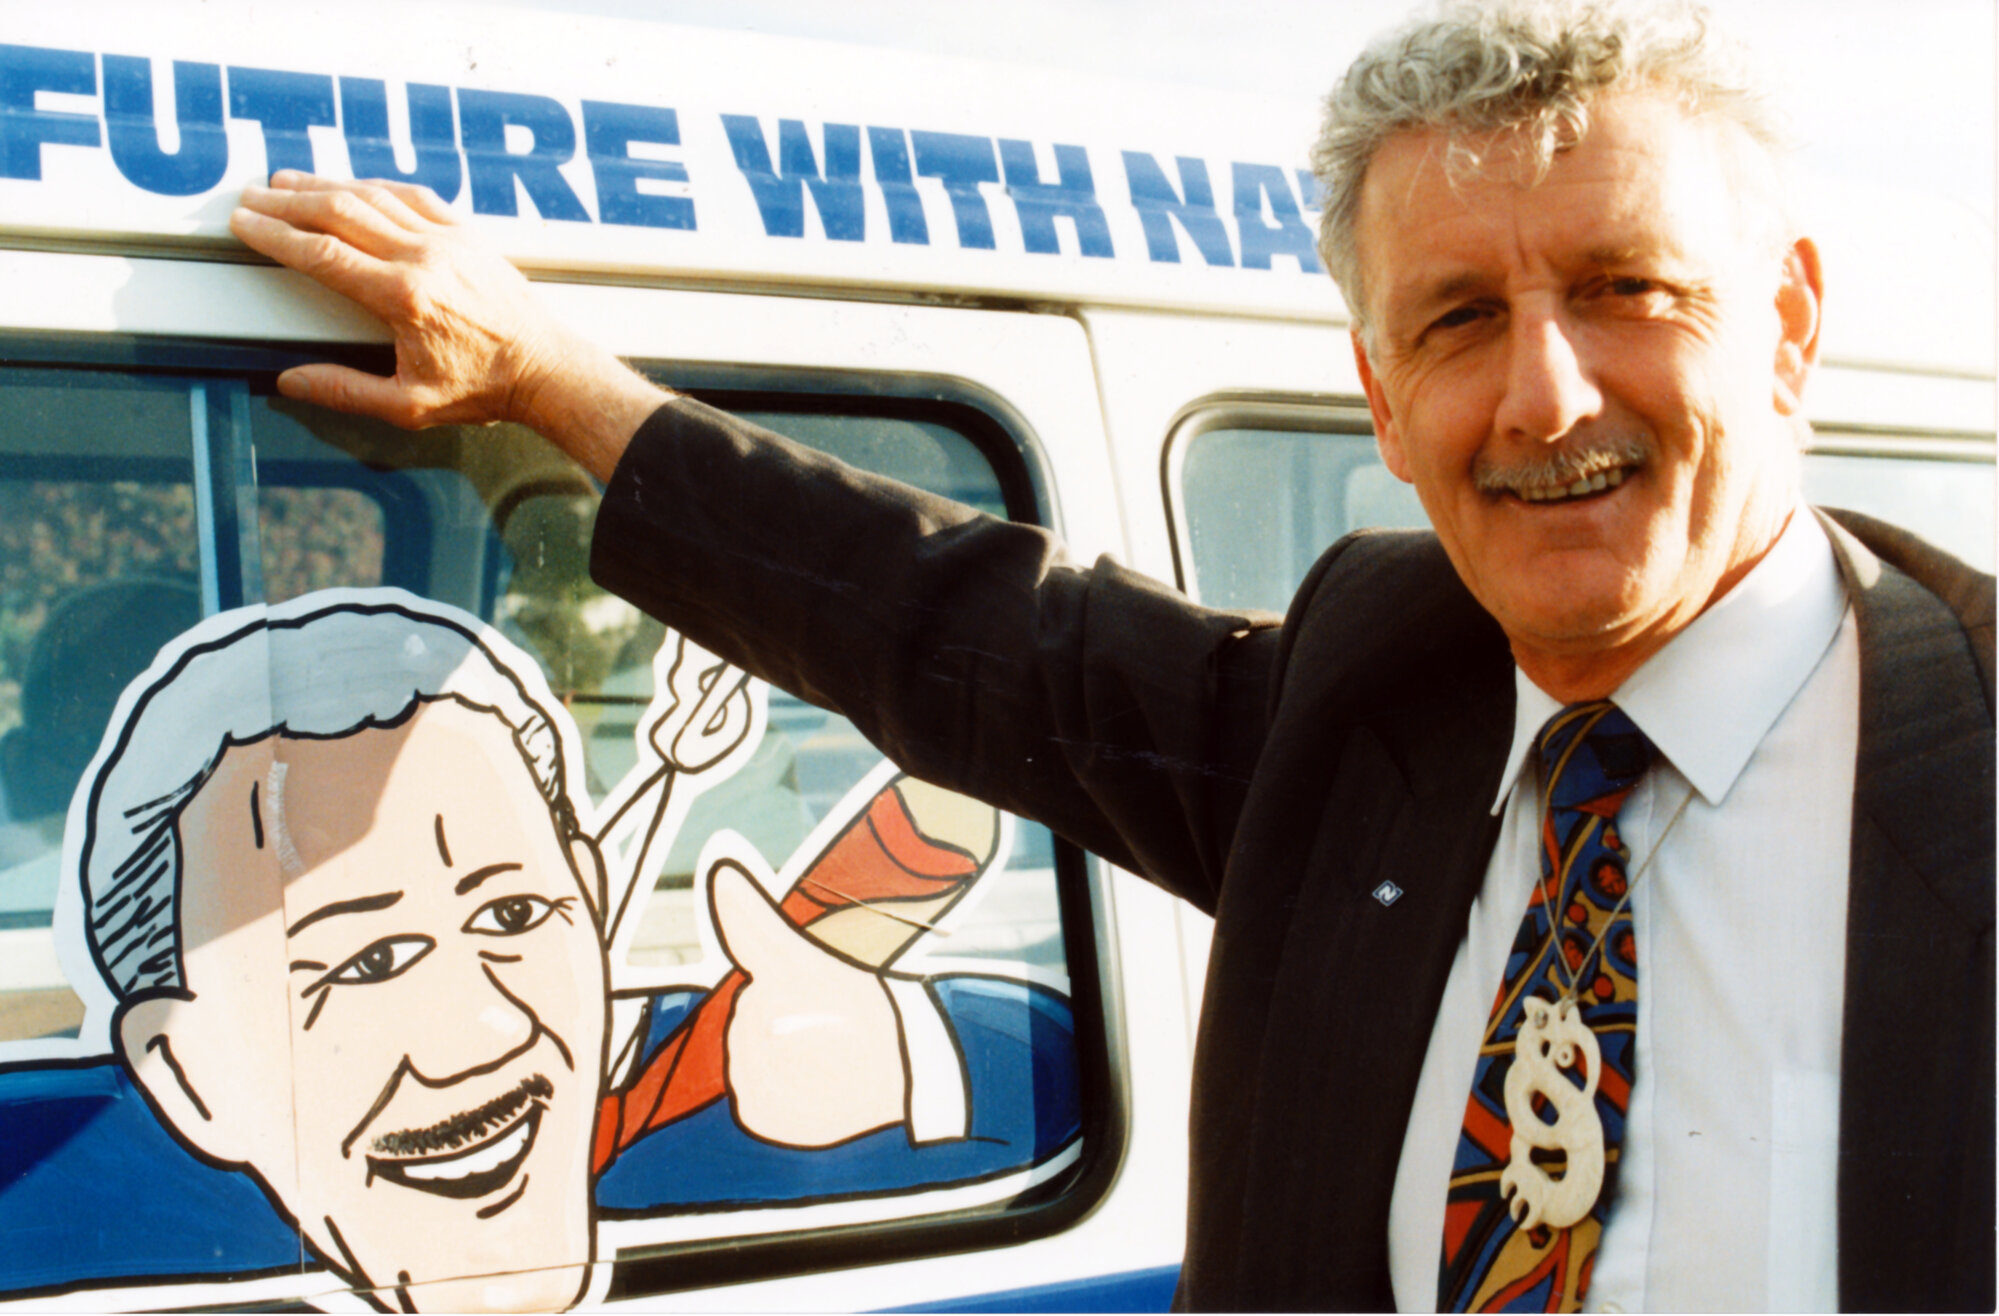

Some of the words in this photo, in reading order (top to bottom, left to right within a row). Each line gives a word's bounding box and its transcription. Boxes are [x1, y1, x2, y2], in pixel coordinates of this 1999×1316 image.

[0, 43, 697, 231] FUTURE
[719, 113, 1115, 258] WITH
[1121, 149, 1327, 275] NA
